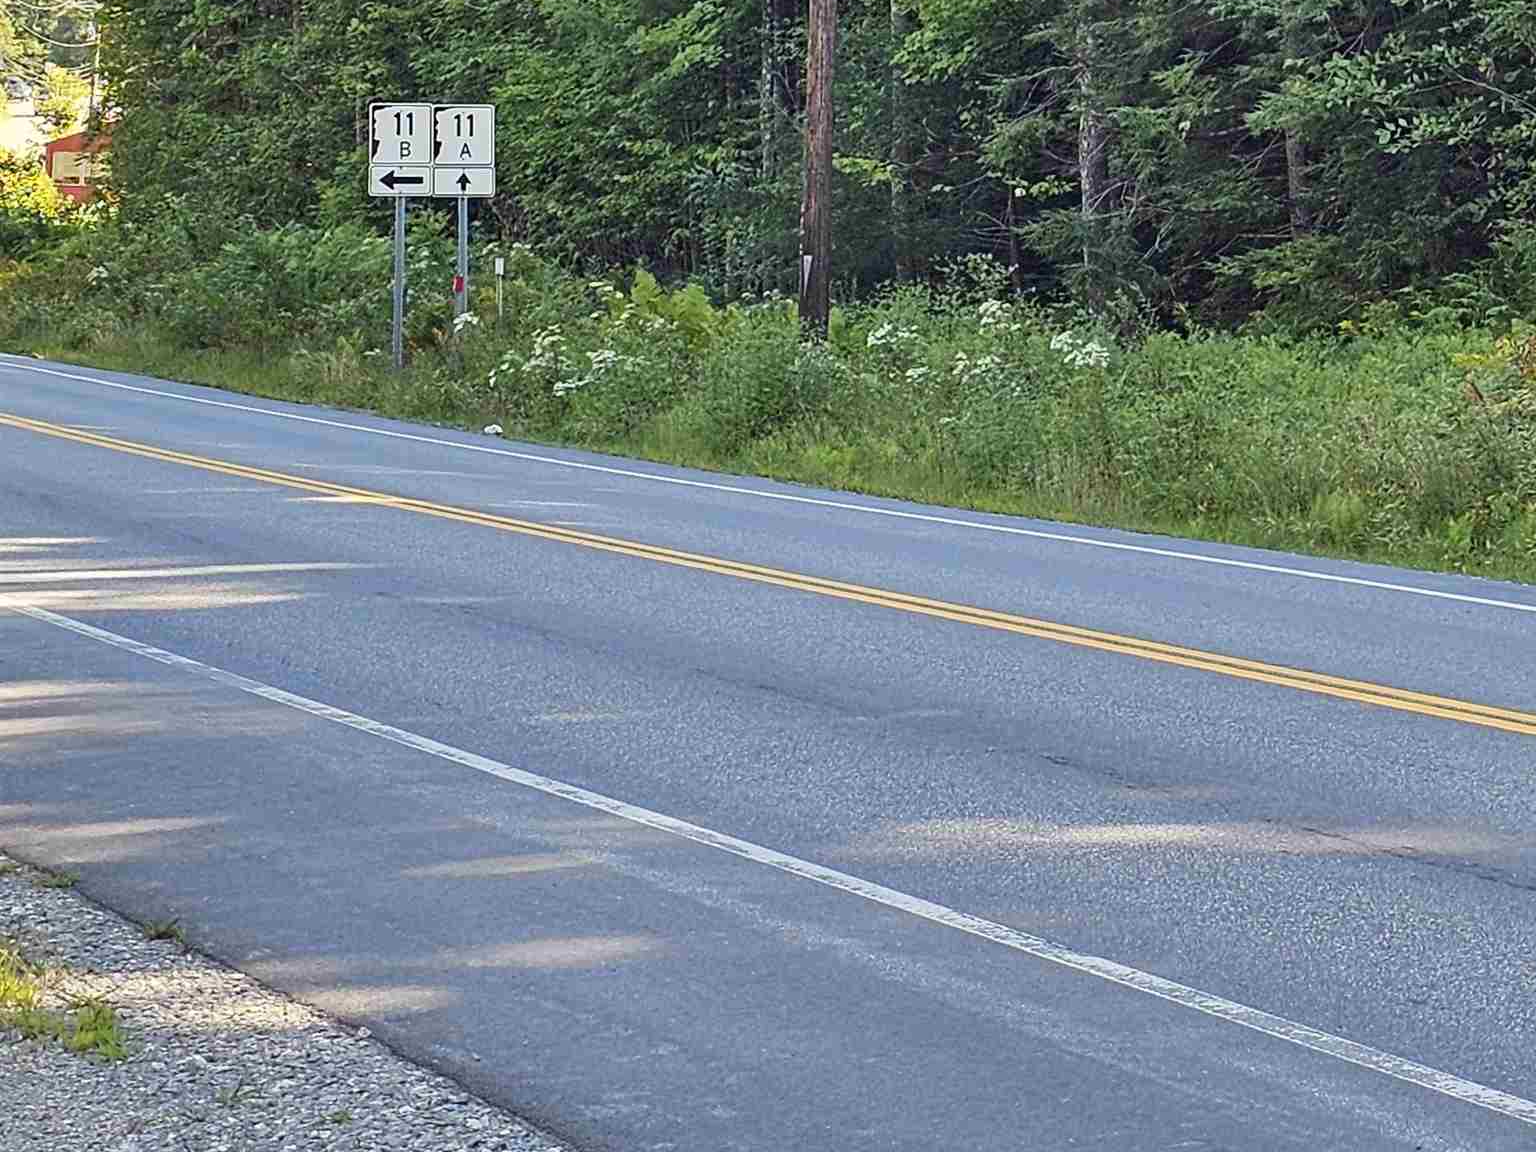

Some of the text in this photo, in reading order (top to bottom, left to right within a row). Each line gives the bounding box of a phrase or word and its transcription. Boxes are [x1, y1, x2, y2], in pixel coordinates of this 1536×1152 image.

[394, 112, 413, 136] 11
[454, 114, 474, 137] 11
[400, 141, 411, 158] B
[460, 143, 472, 159] A
